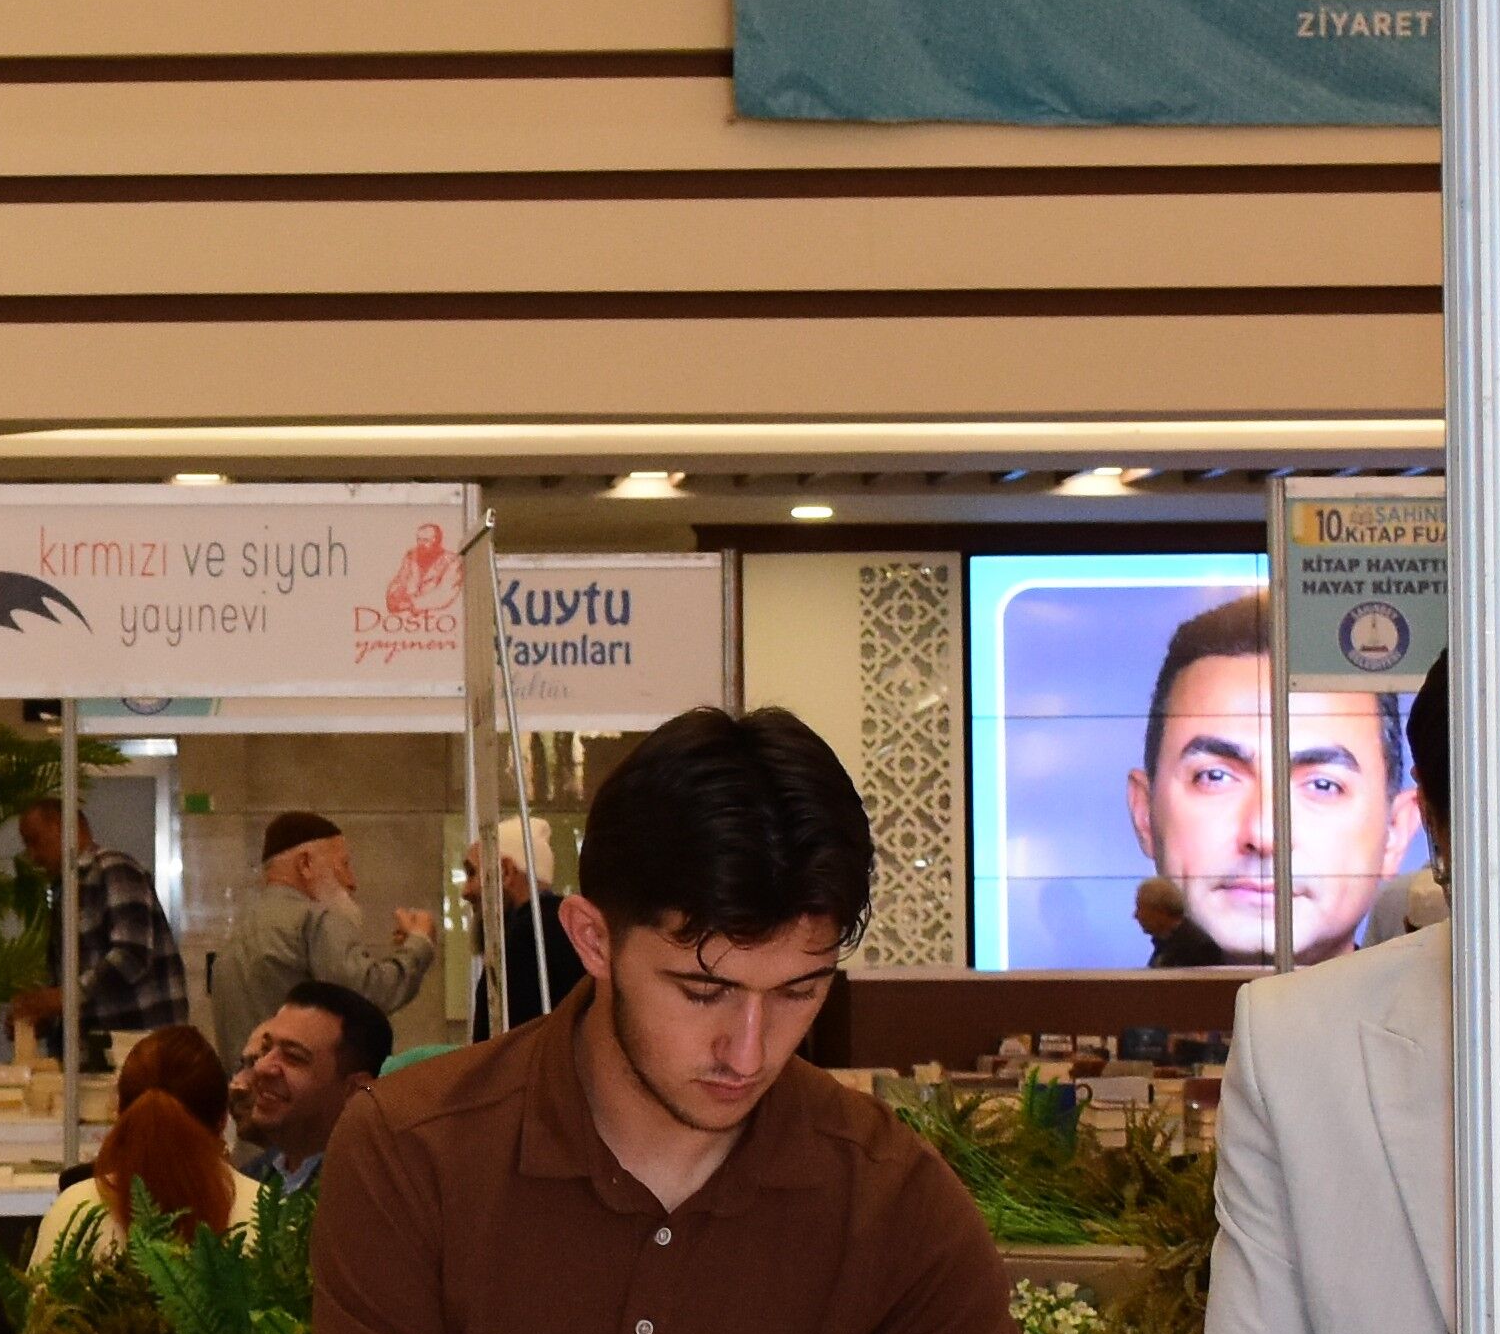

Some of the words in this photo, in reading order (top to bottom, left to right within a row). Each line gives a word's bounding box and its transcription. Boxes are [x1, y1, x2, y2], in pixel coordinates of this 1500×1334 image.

[39, 527, 168, 577] kırmızı
[183, 540, 226, 577] ve
[242, 526, 348, 594] siyah
[1367, 557, 1447, 574] HAYATTI
[1303, 579, 1366, 596] HAYAT
[1372, 576, 1447, 596] KİTAPTI
[120, 590, 267, 647] yayınevi
